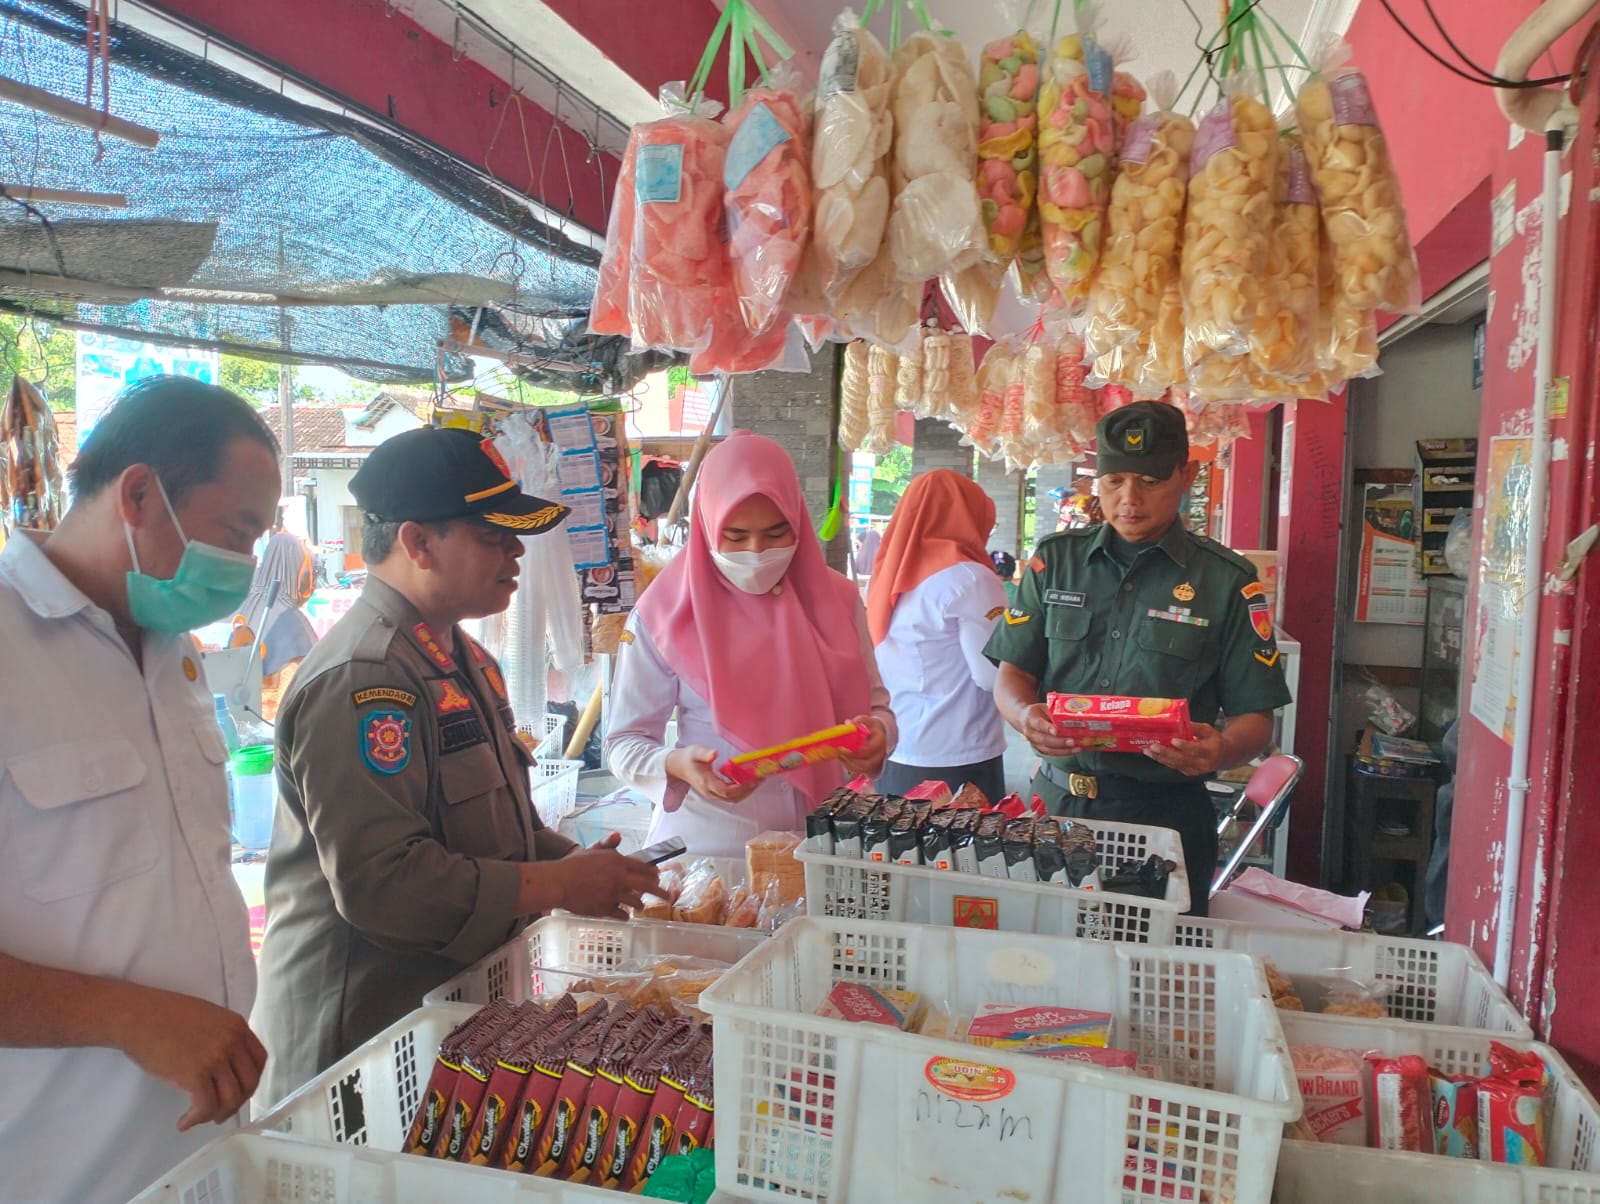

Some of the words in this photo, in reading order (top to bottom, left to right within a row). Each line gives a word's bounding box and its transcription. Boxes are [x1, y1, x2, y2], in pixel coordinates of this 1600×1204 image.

[357, 689, 416, 706] KEMENDAGRI
[1099, 699, 1132, 712] Kelapa
[1316, 1076, 1359, 1096] BRAND
[1309, 1106, 1351, 1134] ackers
